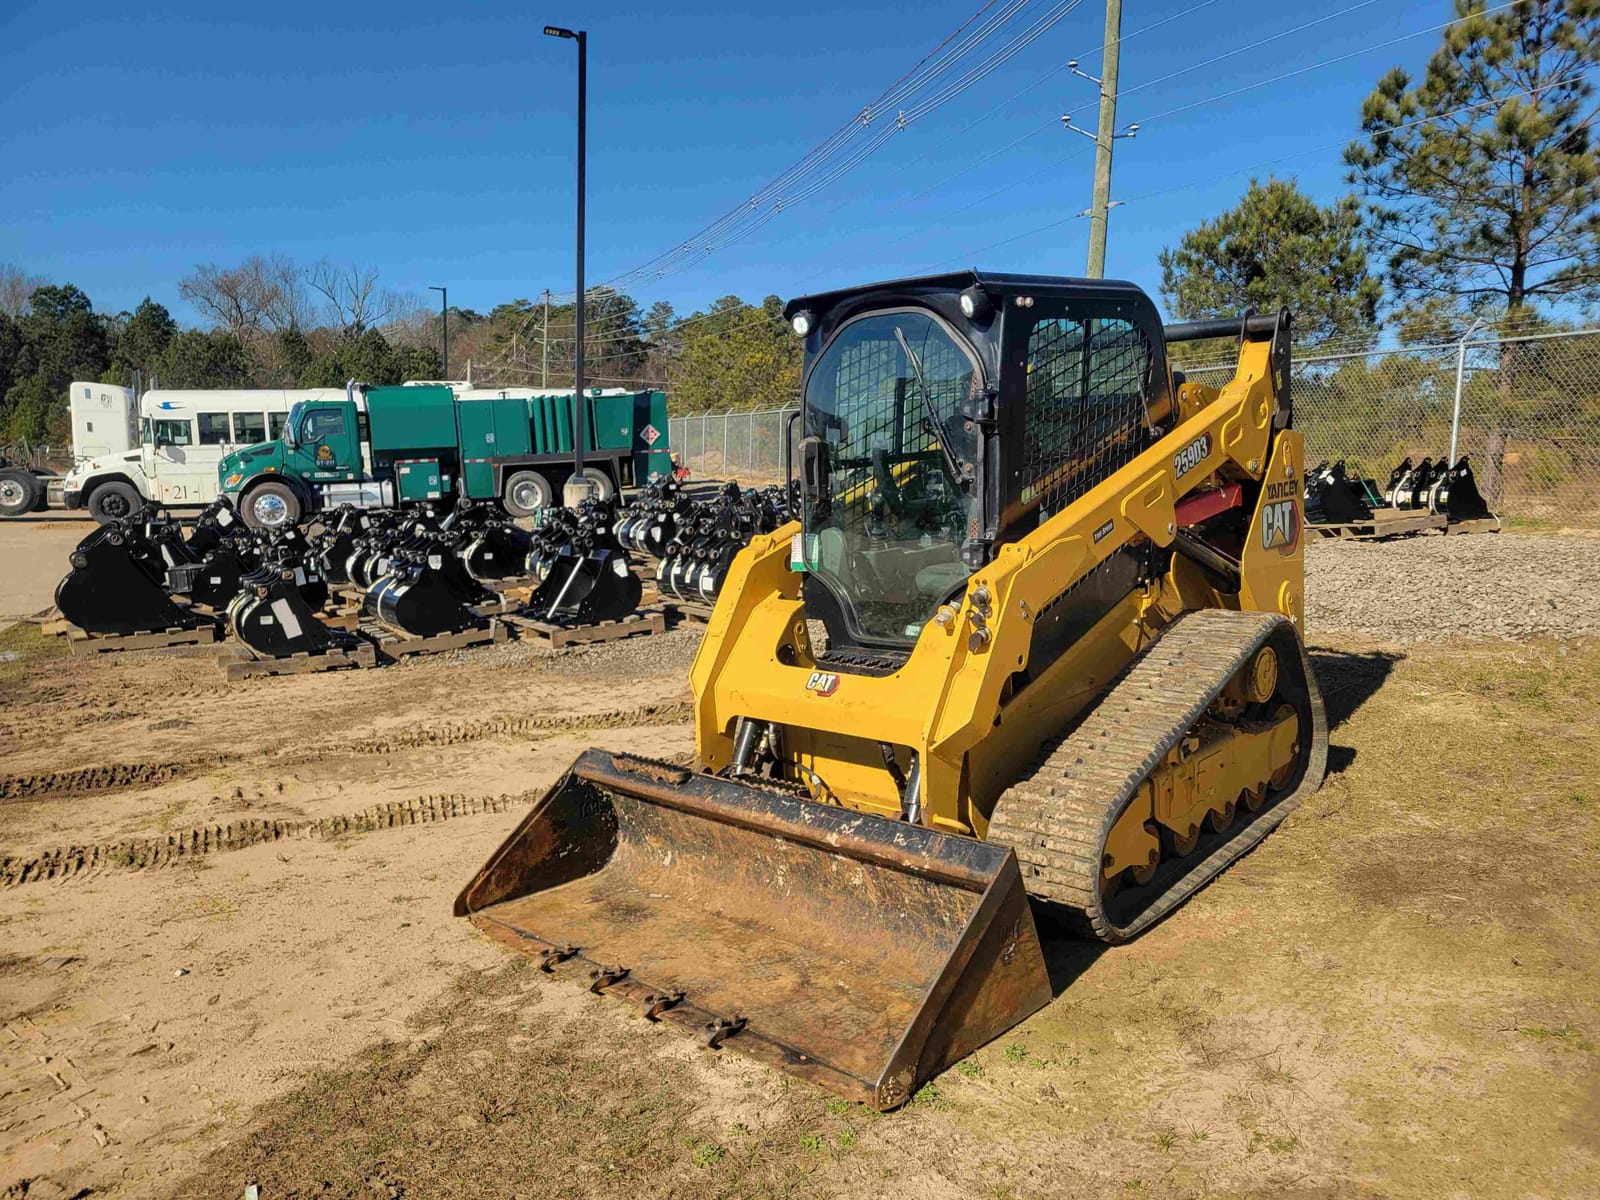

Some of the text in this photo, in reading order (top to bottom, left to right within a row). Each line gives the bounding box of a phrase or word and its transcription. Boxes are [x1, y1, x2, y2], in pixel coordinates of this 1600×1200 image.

[1174, 437, 1208, 477] 259D3
[172, 485, 187, 499] 21
[1267, 480, 1299, 500] YANCEY
[1262, 502, 1292, 549] CAT
[806, 672, 836, 692] CAT
